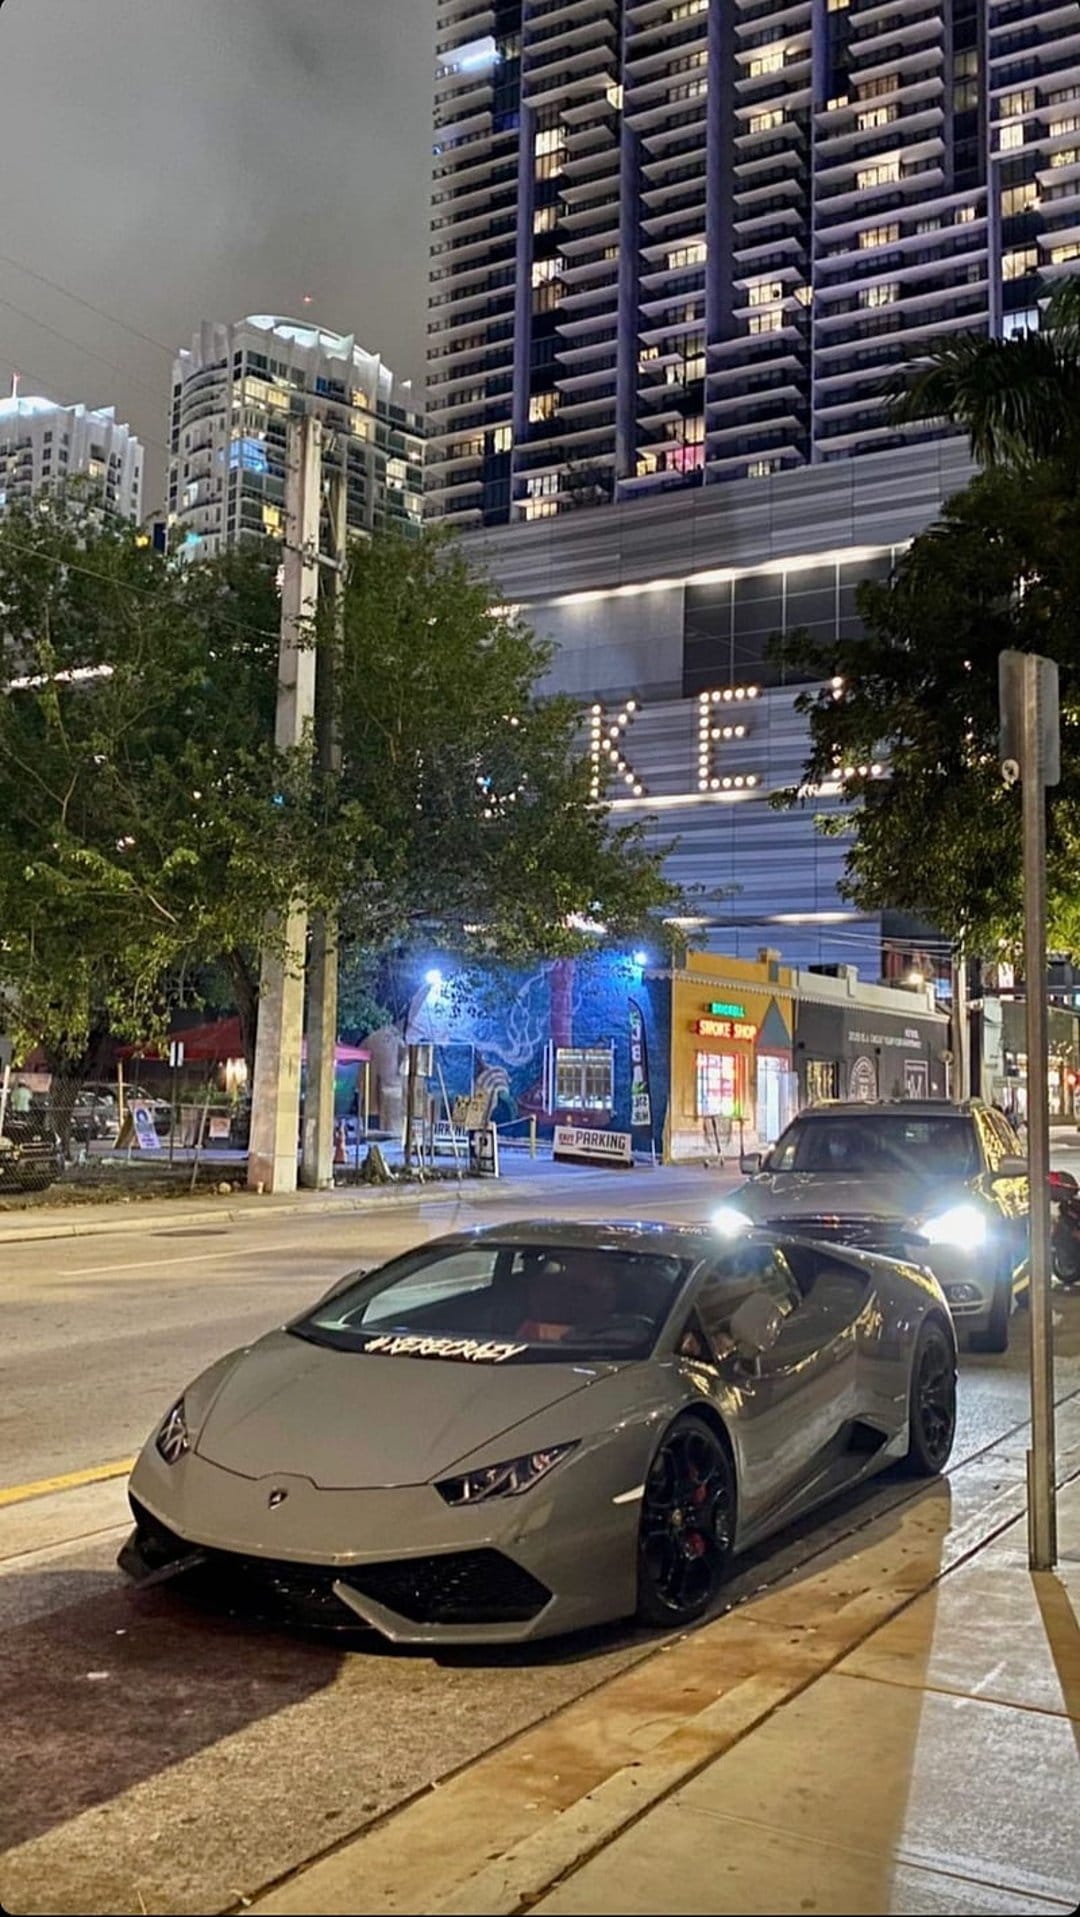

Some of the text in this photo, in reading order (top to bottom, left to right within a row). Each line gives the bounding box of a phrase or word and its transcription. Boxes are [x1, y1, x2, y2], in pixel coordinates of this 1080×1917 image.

[700, 1020, 757, 1040] SMOKE SHOP
[575, 1130, 626, 1150] PARKING
